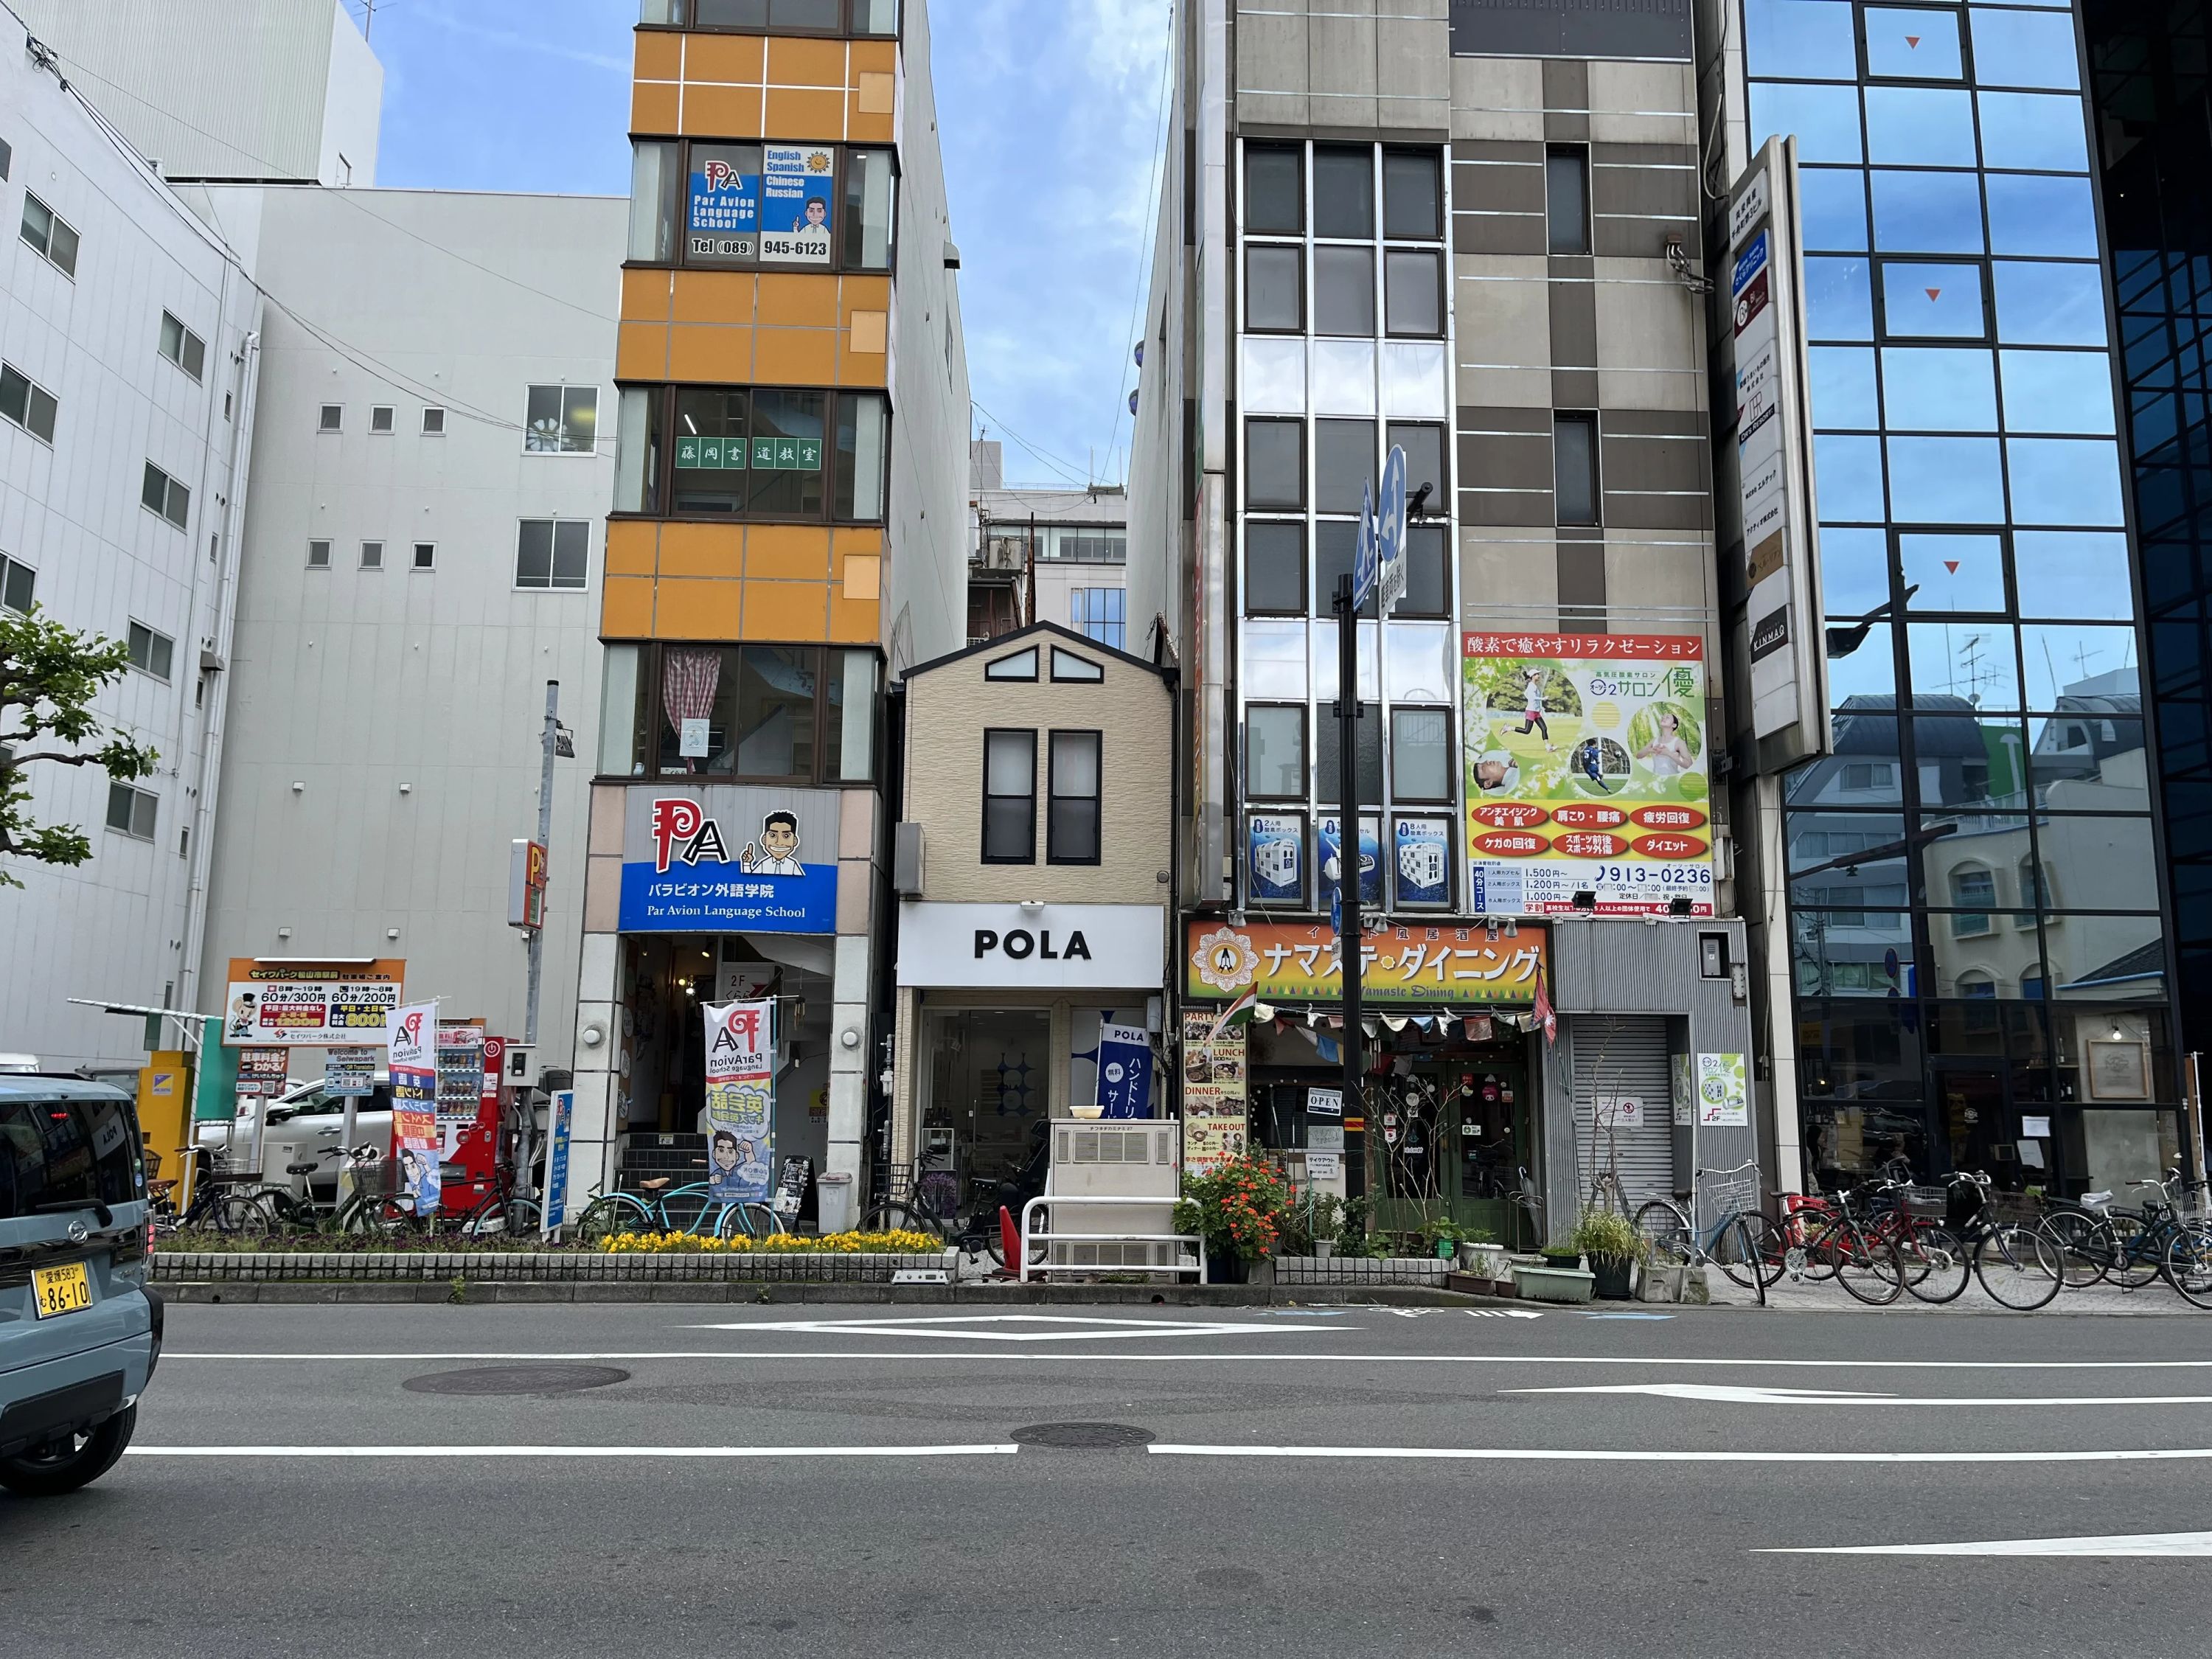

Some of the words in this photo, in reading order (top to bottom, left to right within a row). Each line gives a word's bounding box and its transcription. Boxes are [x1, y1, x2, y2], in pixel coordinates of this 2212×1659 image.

[767, 150, 801, 161] English
[767, 162, 804, 173] Spanish
[706, 161, 742, 192] PA
[766, 175, 805, 187] Chinese
[765, 187, 804, 198] Russian
[694, 195, 715, 206] Par
[720, 196, 755, 207] Avion
[694, 206, 754, 219] Language
[693, 217, 737, 229] School
[693, 239, 714, 253] Tel
[764, 241, 827, 255] 945-6123
[681, 445, 817, 462] 藤岡書道教室
[1753, 625, 1785, 651] KINMAQ
[1467, 636, 1700, 655] 酸素で癒やすリラクゼーション
[1479, 807, 1538, 817] アンチエイジング
[1557, 810, 1621, 824] 肩こり・腰痛
[1643, 812, 1691, 824] 疲労回復
[654, 799, 728, 872] PA
[1565, 835, 1613, 845] スポーツ前後
[1485, 836, 1536, 849] ケガの回復
[1646, 840, 1688, 852] ダイエット
[1565, 844, 1613, 855] スポーツ外傷
[531, 846, 540, 885] P
[1610, 867, 1711, 883] 913-0236
[648, 883, 775, 898] パラビオン外語学院
[1474, 870, 1484, 911] 40分コース
[647, 905, 665, 916] Par
[667, 905, 700, 916] Avion
[704, 905, 762, 919] Language
[765, 906, 806, 918] School
[1526, 903, 1543, 912] 学割
[974, 929, 1092, 960] POLA
[731, 975, 746, 987] 2F
[262, 993, 326, 1003] 60分/300円
[332, 993, 396, 1003] 60分/200円
[1411, 984, 1454, 1001] Dining
[1185, 1012, 1215, 1021] PARTY
[1114, 1029, 1144, 1042] POLA
[1214, 1048, 1245, 1057] LUNCH
[1185, 1087, 1221, 1095] DINNER
[1311, 1096, 1339, 1107] OPEN
[48, 1281, 88, 1311] 86-10
